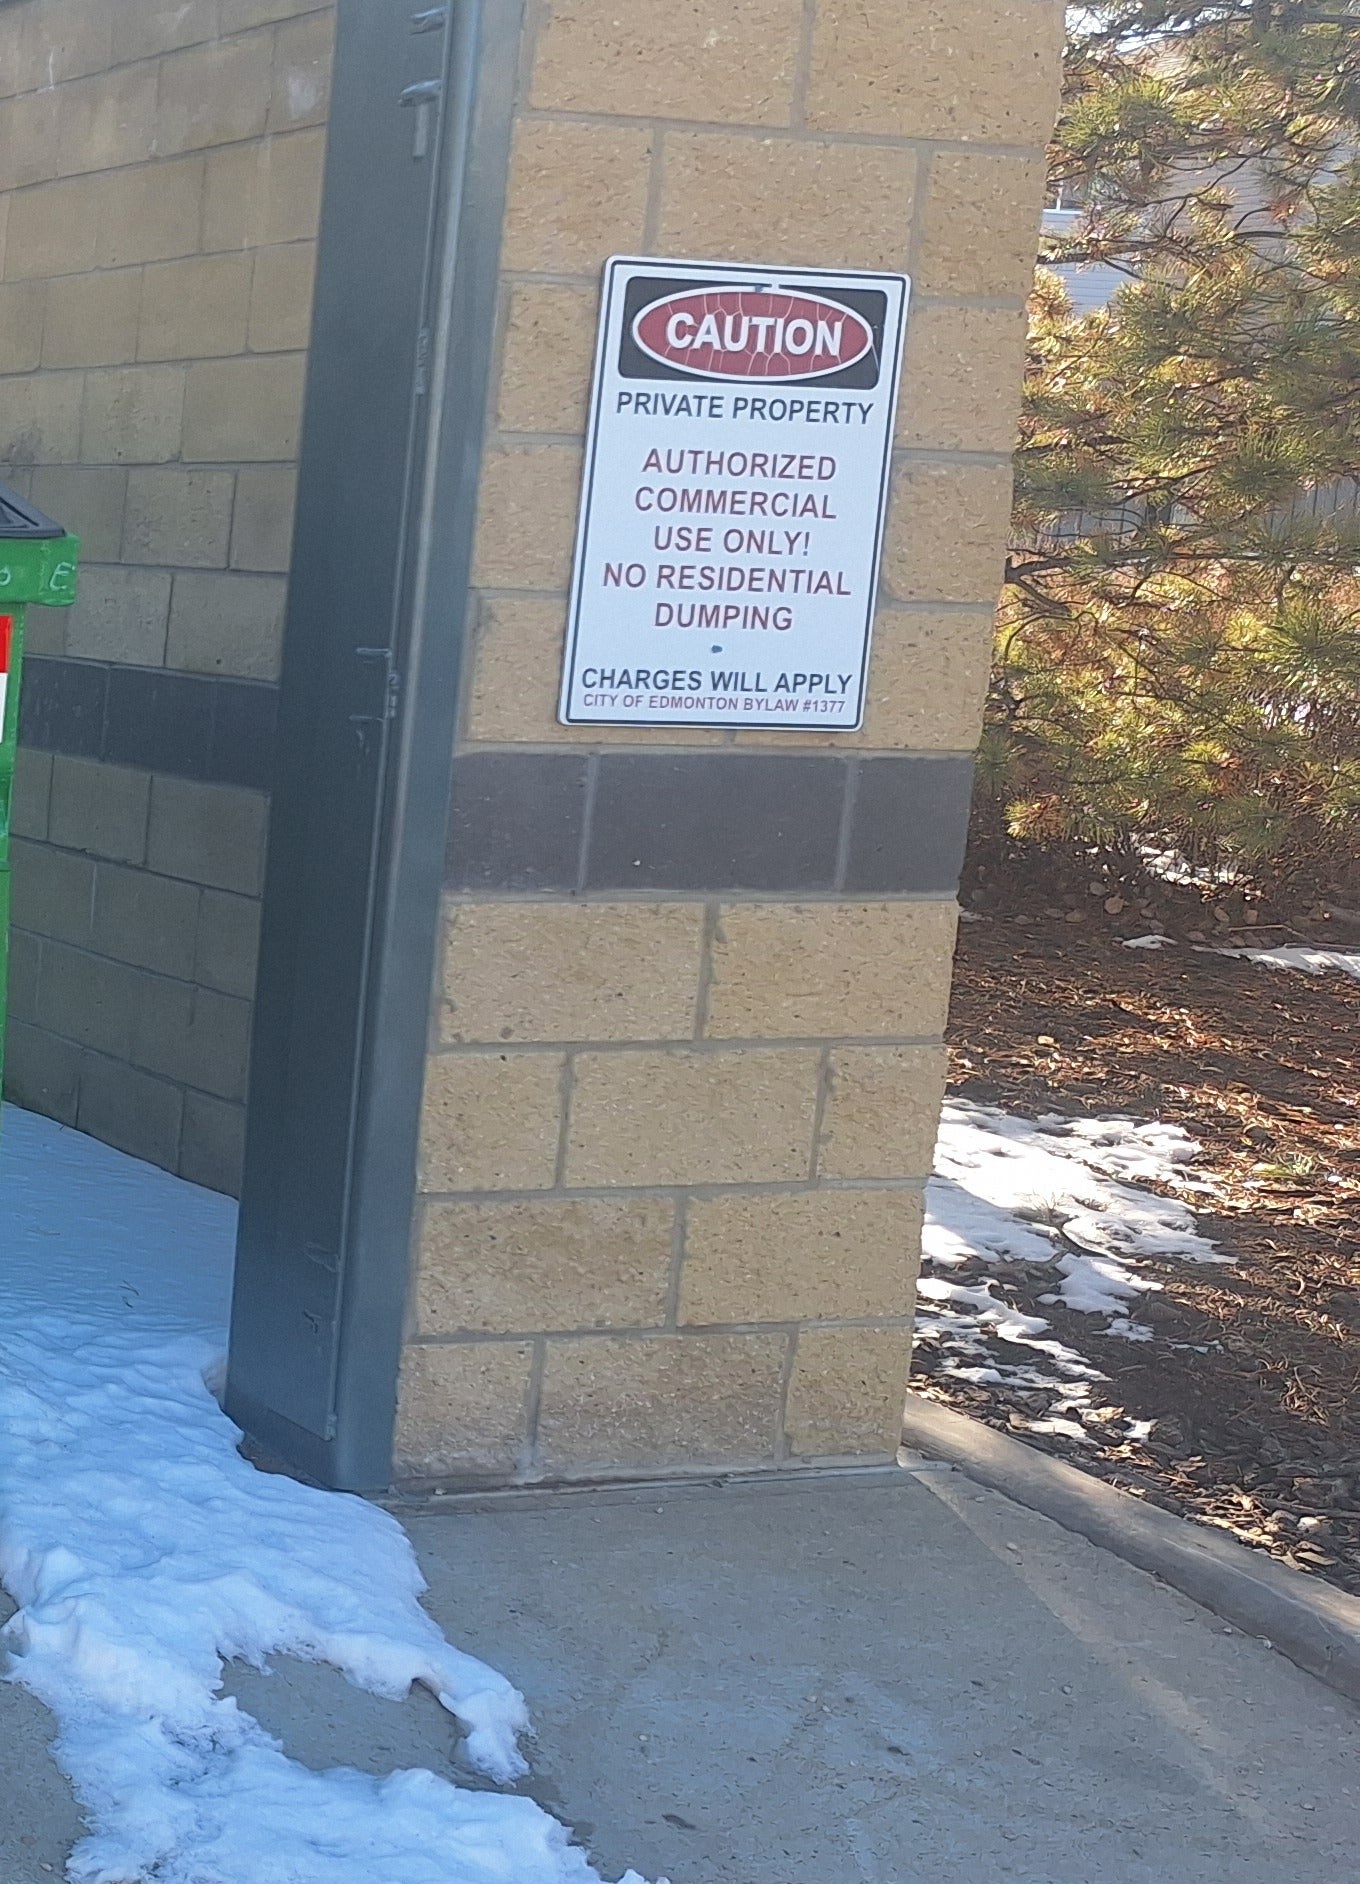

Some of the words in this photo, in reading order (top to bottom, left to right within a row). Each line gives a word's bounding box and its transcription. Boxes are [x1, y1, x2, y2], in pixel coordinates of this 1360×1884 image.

[667, 312, 843, 356] CAUTION
[616, 392, 724, 418] PRIVATE
[733, 397, 873, 425] PROPERTY
[642, 449, 836, 481] AUTHORIZED
[635, 486, 837, 519] COMMERCIAL
[654, 526, 712, 552] USE
[723, 529, 810, 556] ONLY!
[603, 563, 646, 588] NO
[656, 564, 851, 596] RESIDENTIAL
[654, 602, 793, 630] DUMPING
[582, 668, 702, 691] CHARGES
[711, 671, 767, 692] WILL
[774, 673, 852, 695] APPLY
[584, 693, 618, 707] CITY
[623, 695, 643, 708] OF
[649, 696, 739, 710] EDMONTON
[744, 698, 799, 712] BYLAW
[803, 699, 845, 713] #1377
